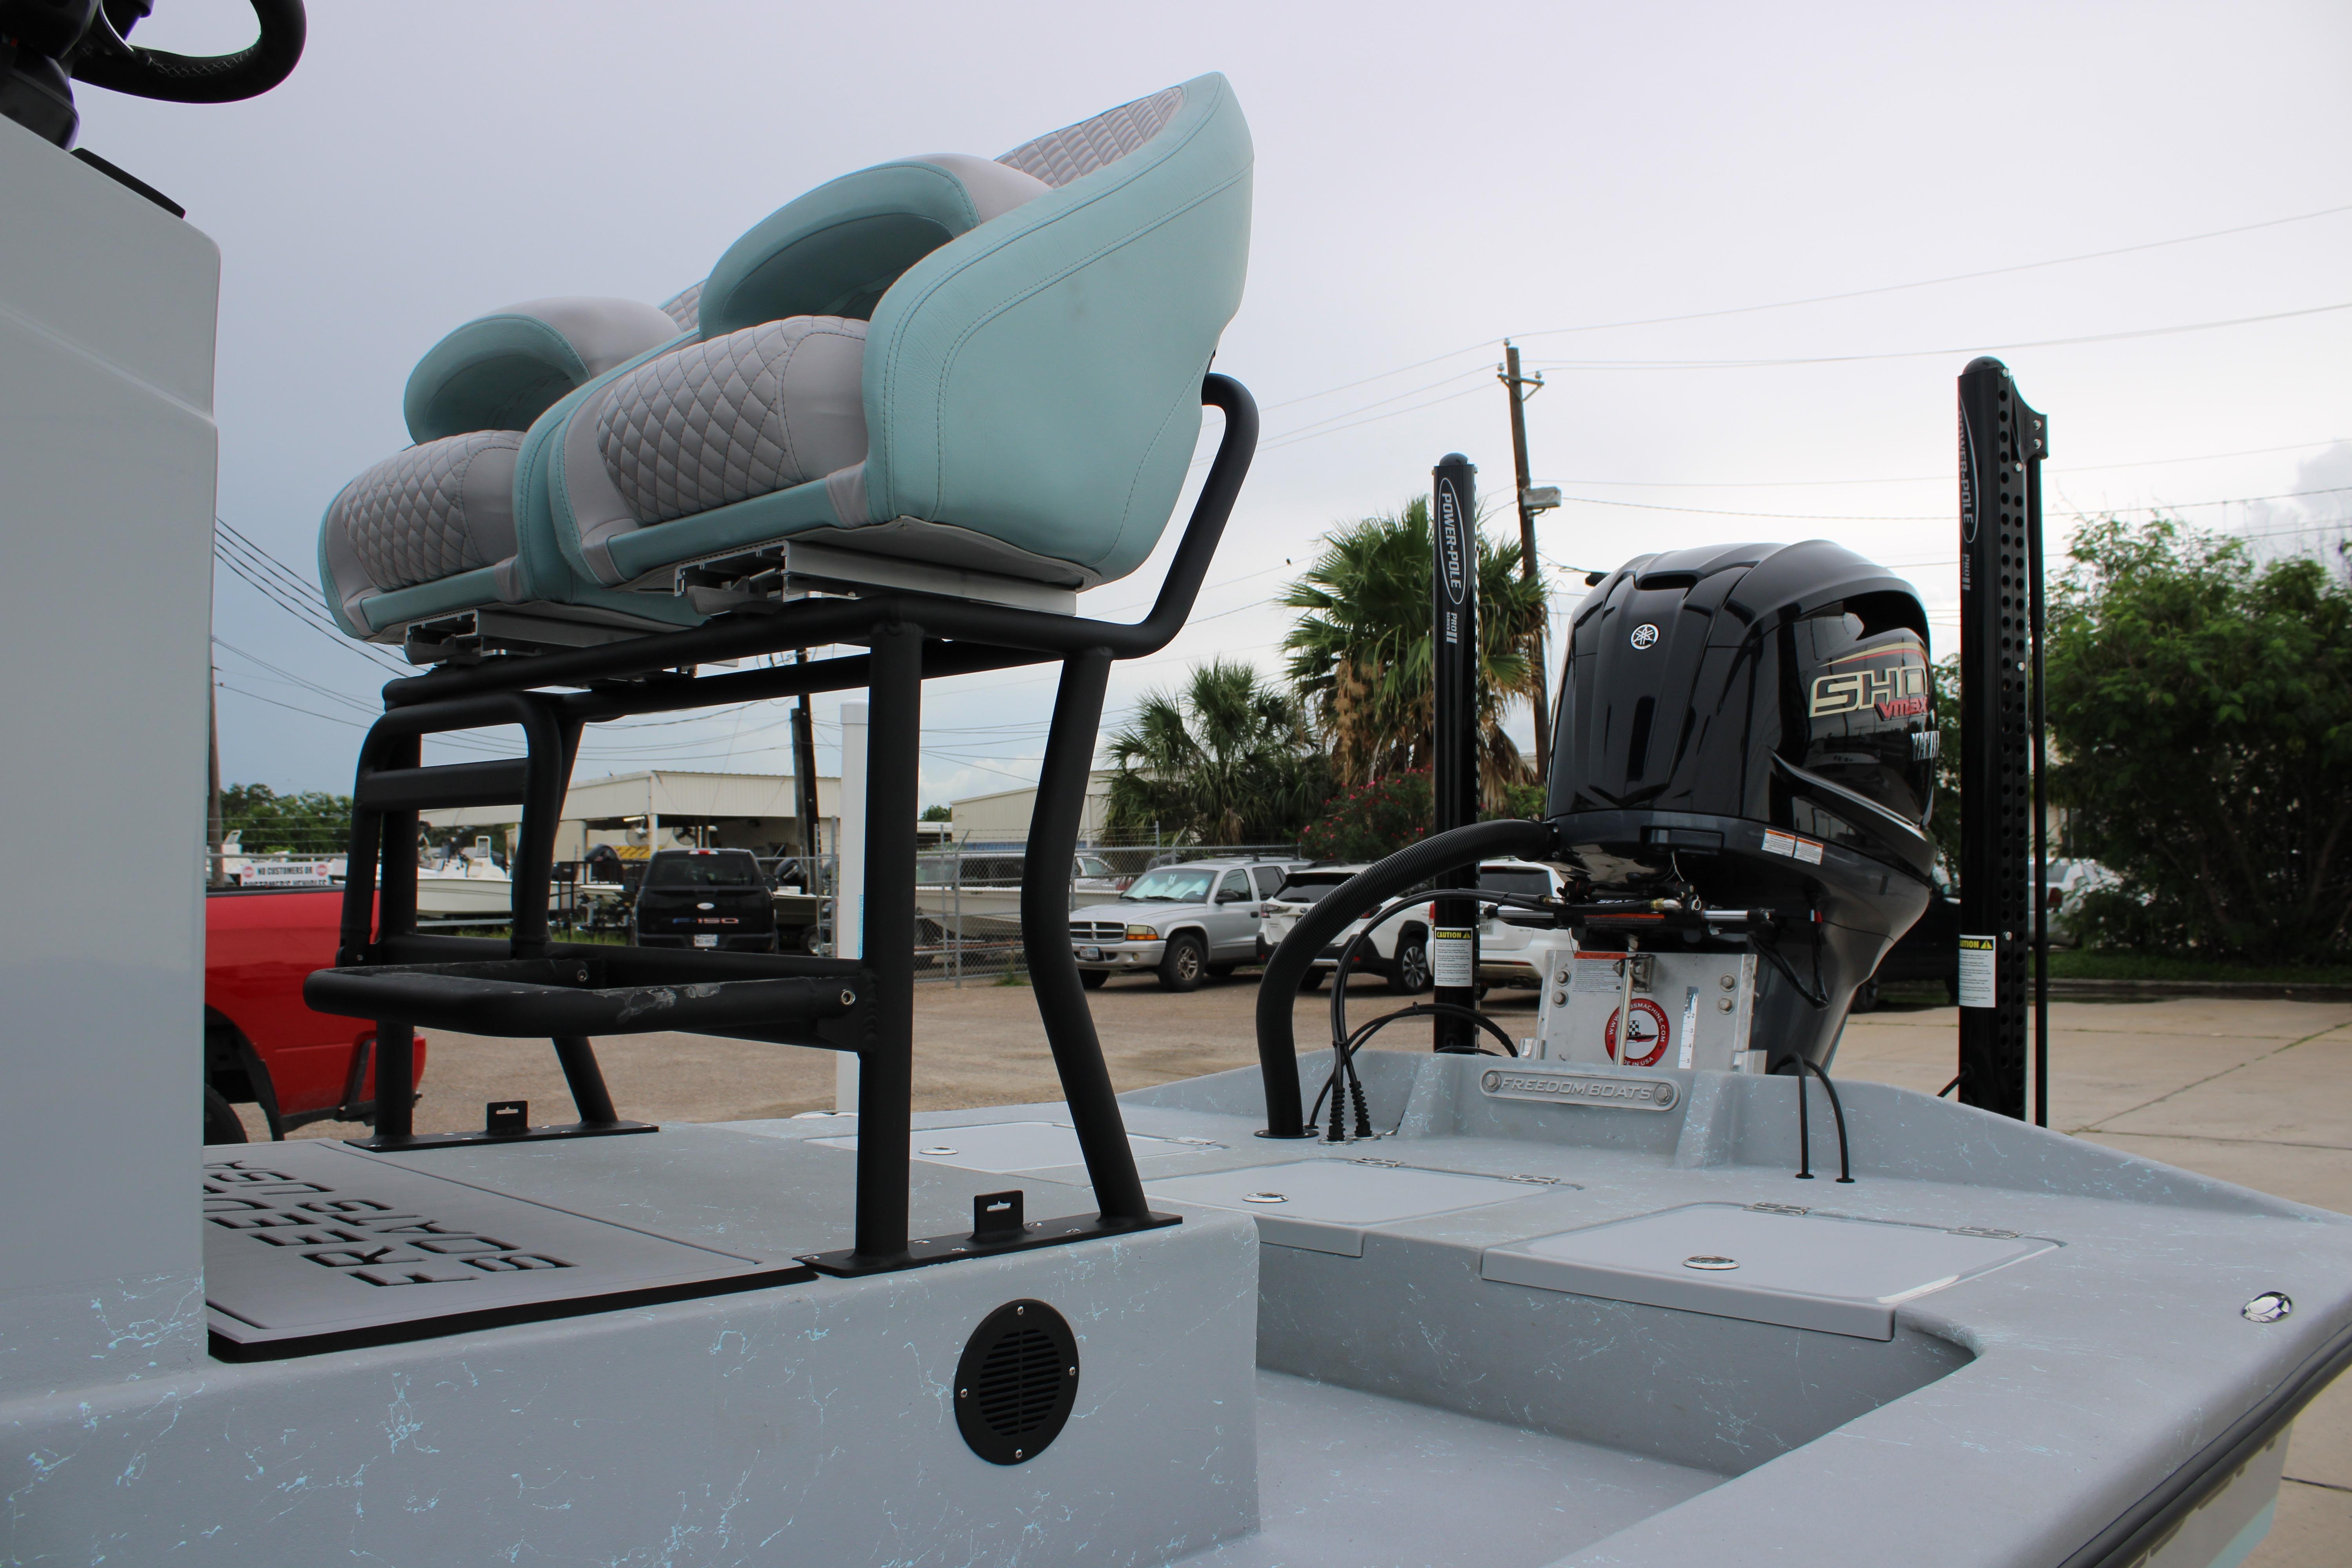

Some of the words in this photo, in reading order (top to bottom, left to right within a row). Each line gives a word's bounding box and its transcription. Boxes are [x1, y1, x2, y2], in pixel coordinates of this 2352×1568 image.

[1441, 493, 1461, 589] POWER-POLE
[267, 867, 304, 875] CUSTOMERS
[1640, 1057, 1654, 1066] USA
[1500, 1078, 1588, 1095] FREEDOM
[1588, 1083, 1651, 1100] BOATS
